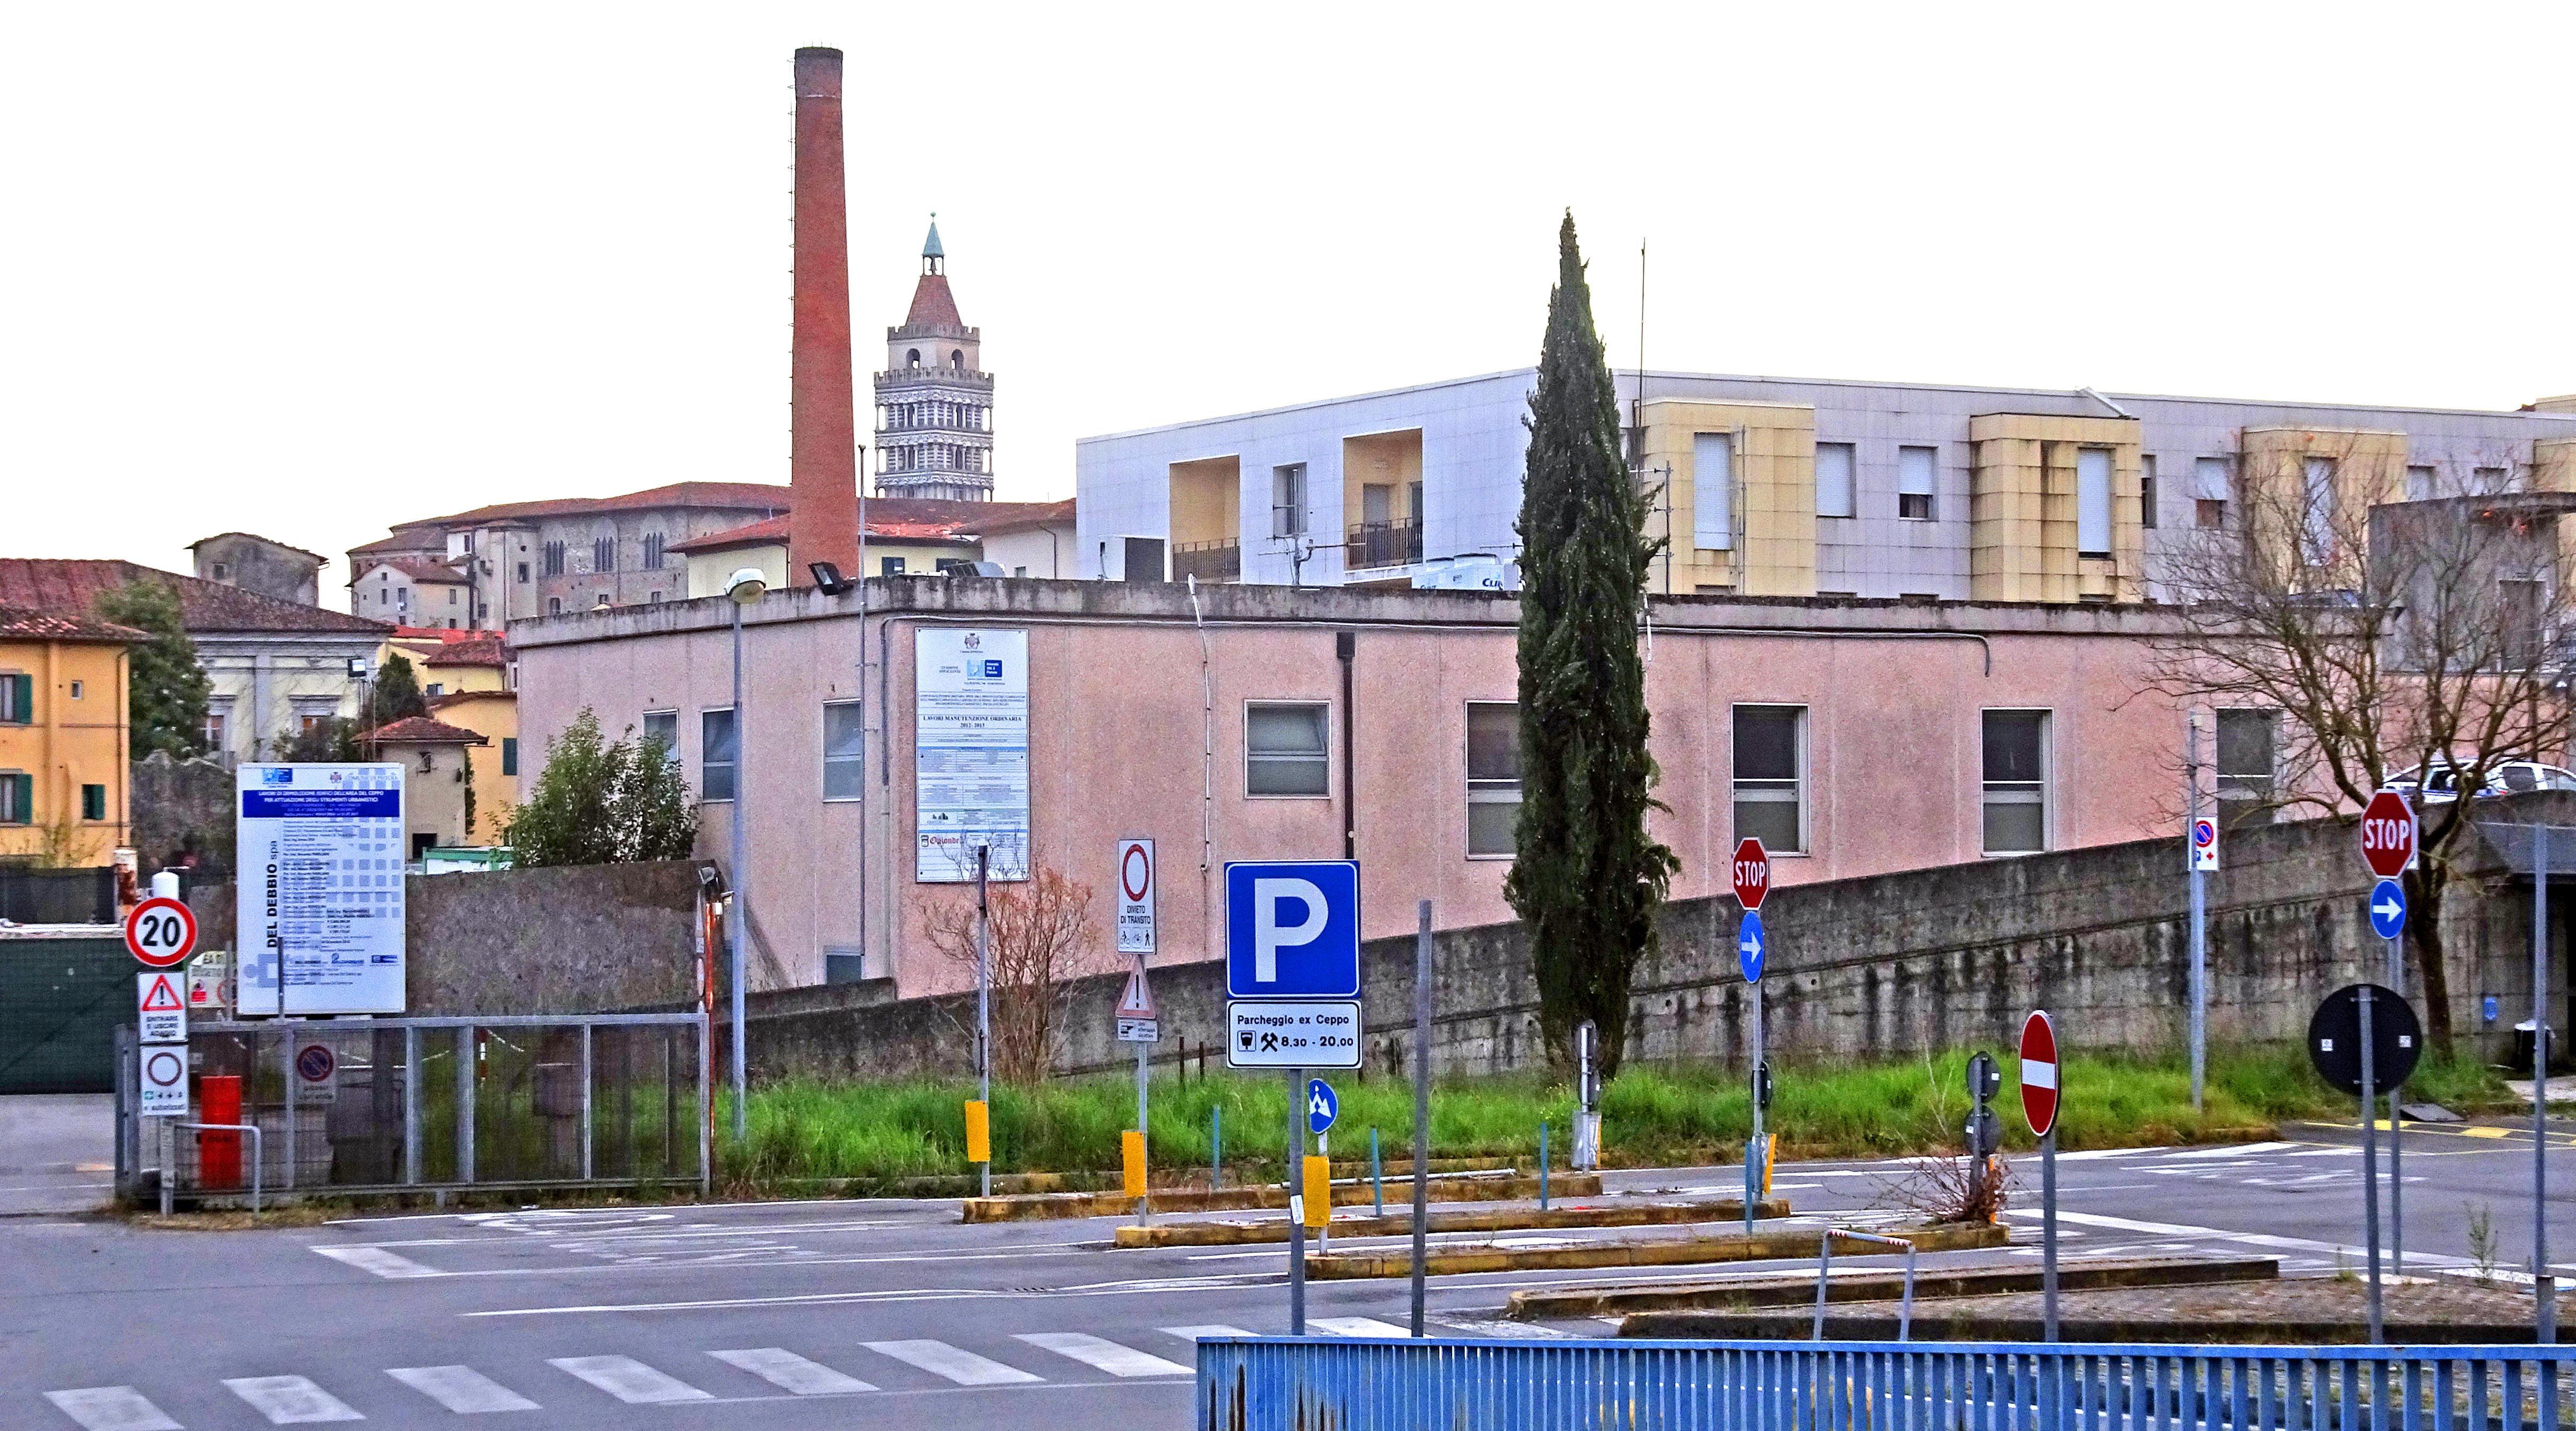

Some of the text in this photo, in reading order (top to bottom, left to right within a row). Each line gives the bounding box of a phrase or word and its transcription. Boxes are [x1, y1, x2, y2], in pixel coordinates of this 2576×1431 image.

[2364, 819, 2410, 850] STOP
[1735, 861, 1766, 887] STOP
[267, 841, 279, 948] DEL DEBBIO spa
[1120, 915, 1151, 925] DI TRANSITO
[1126, 905, 1146, 914] DIVIETO
[141, 915, 181, 947] 20
[1254, 877, 1329, 982] P
[1237, 1014, 1293, 1026] Parcheggio
[1316, 1014, 1350, 1026] Ceppo
[1281, 1036, 1307, 1047] 8.30
[1319, 1036, 1354, 1047] 20.00
